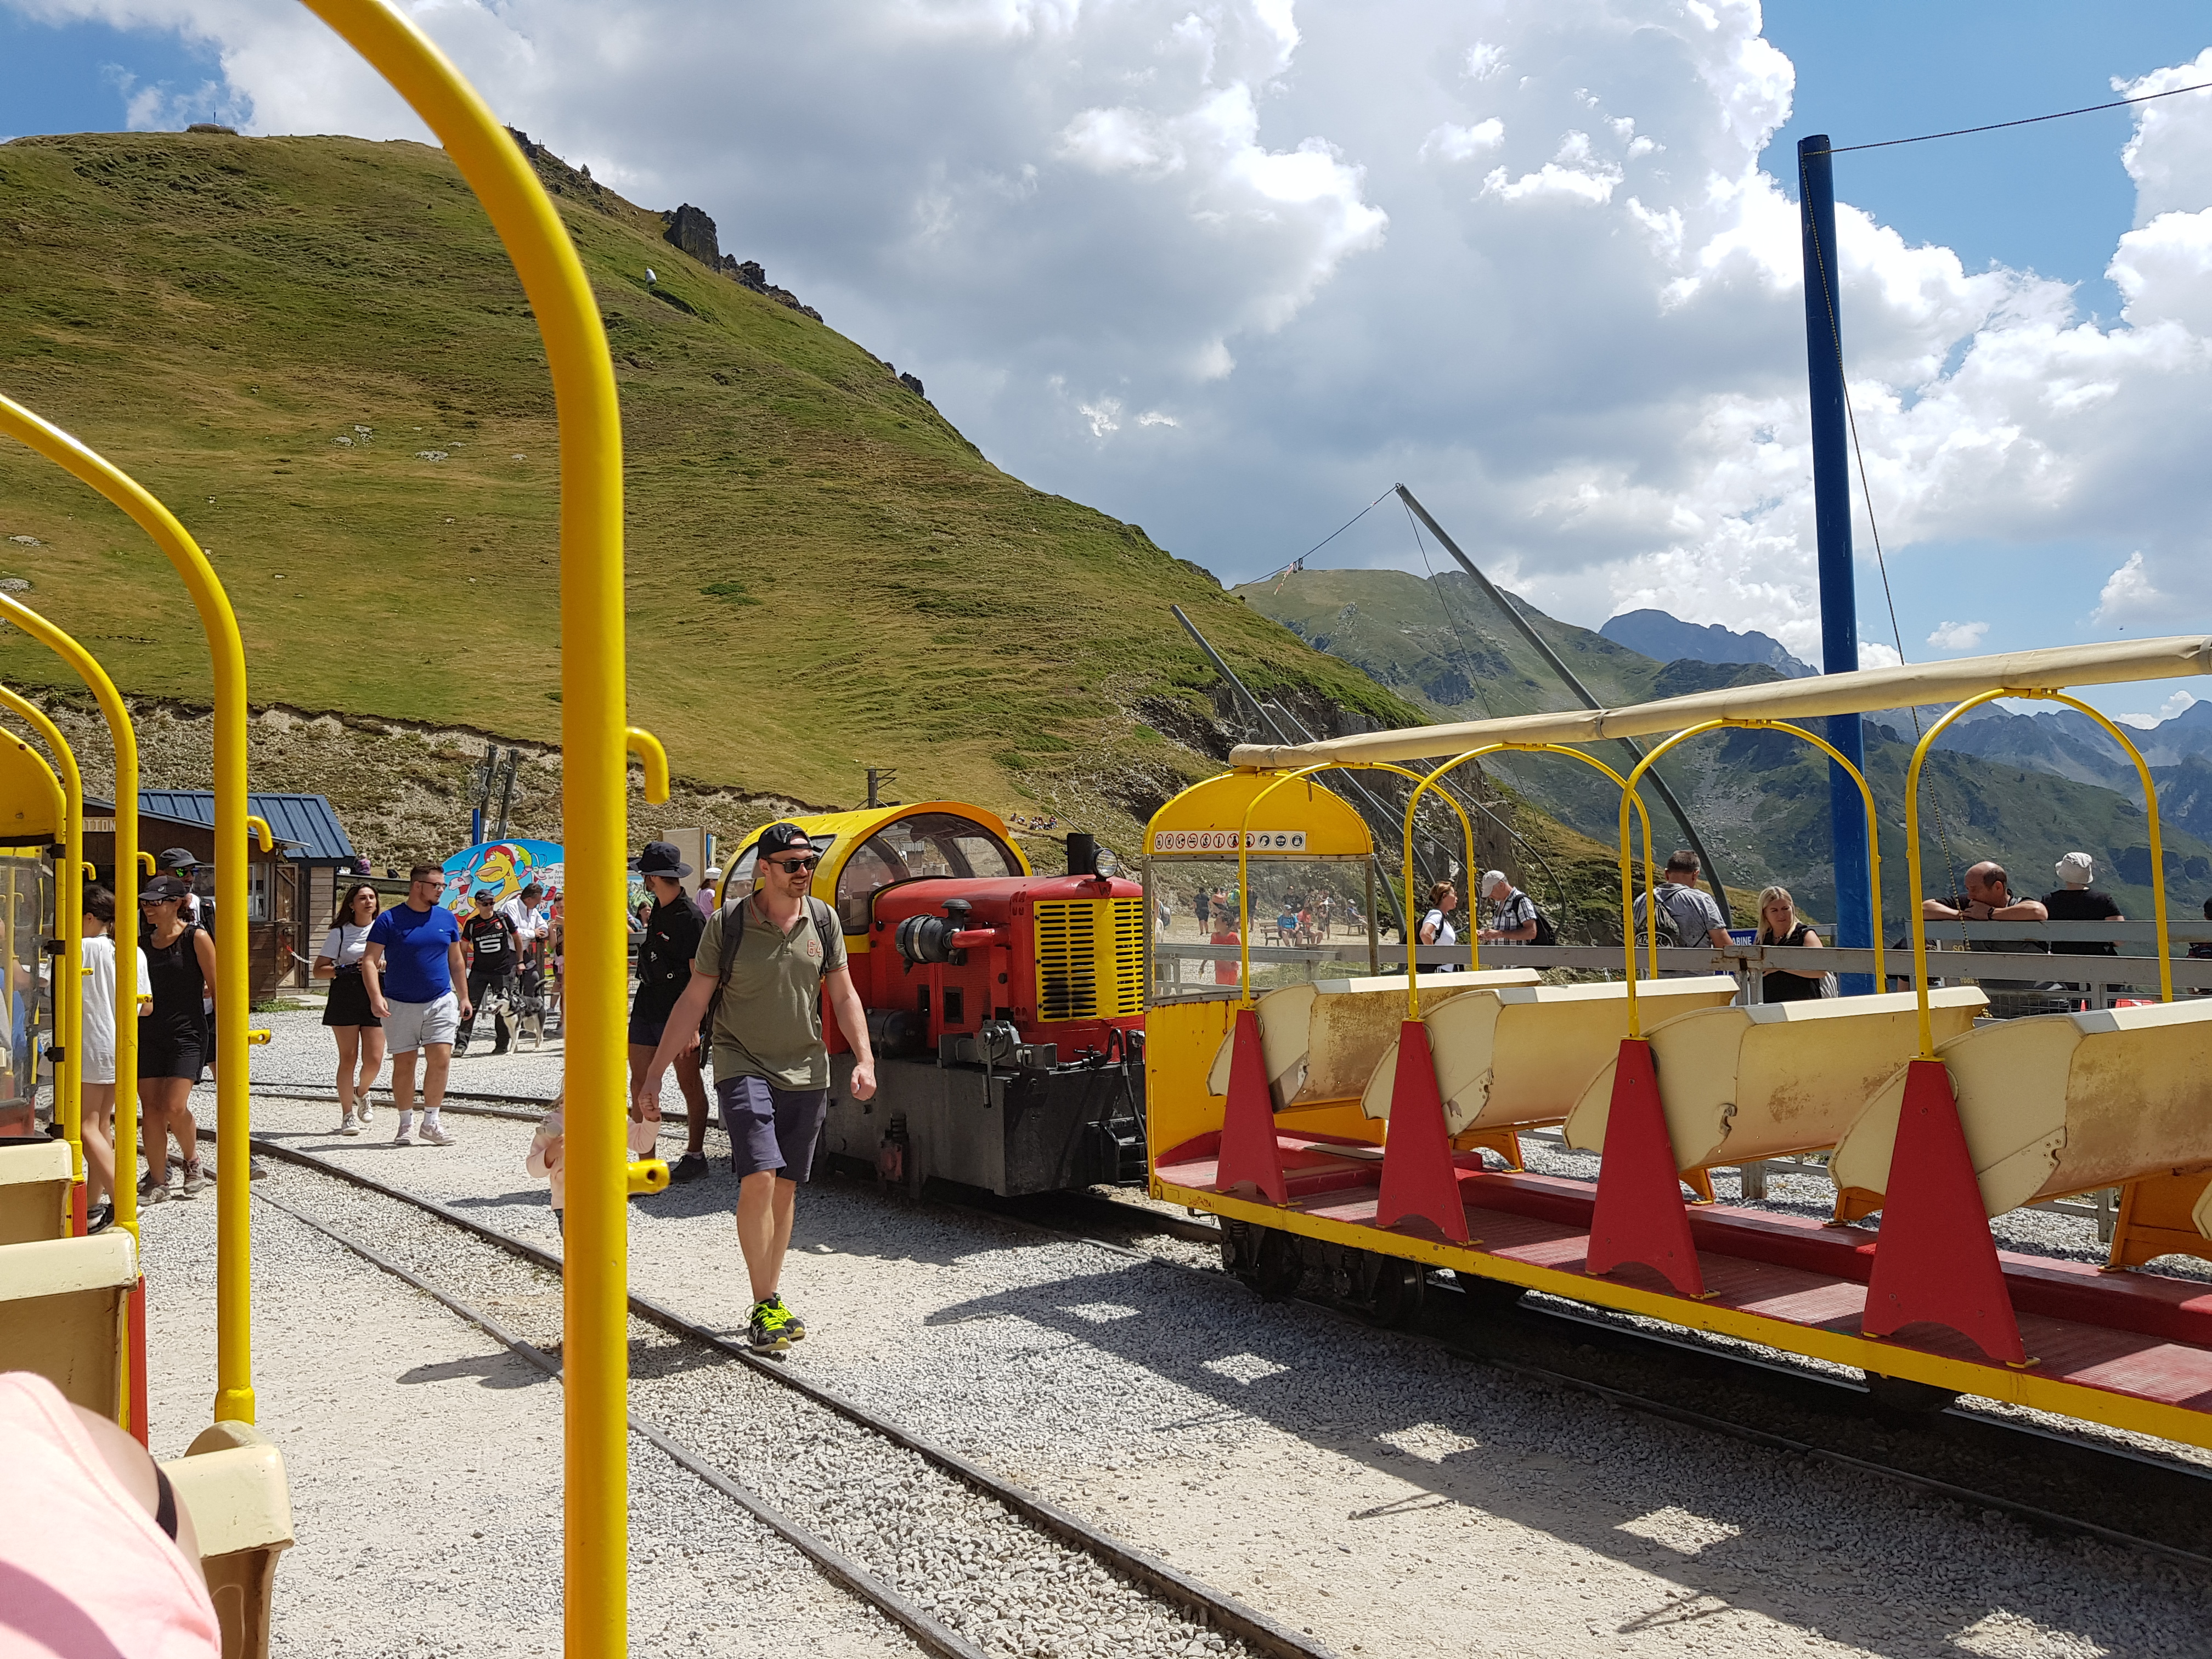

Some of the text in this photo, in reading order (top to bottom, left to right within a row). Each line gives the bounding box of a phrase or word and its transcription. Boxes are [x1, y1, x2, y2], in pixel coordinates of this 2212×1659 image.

[83, 819, 116, 832] TION
[475, 932, 504, 941] SAMSIC
[1732, 936, 1752, 946] ABINE
[807, 939, 822, 957] 64
